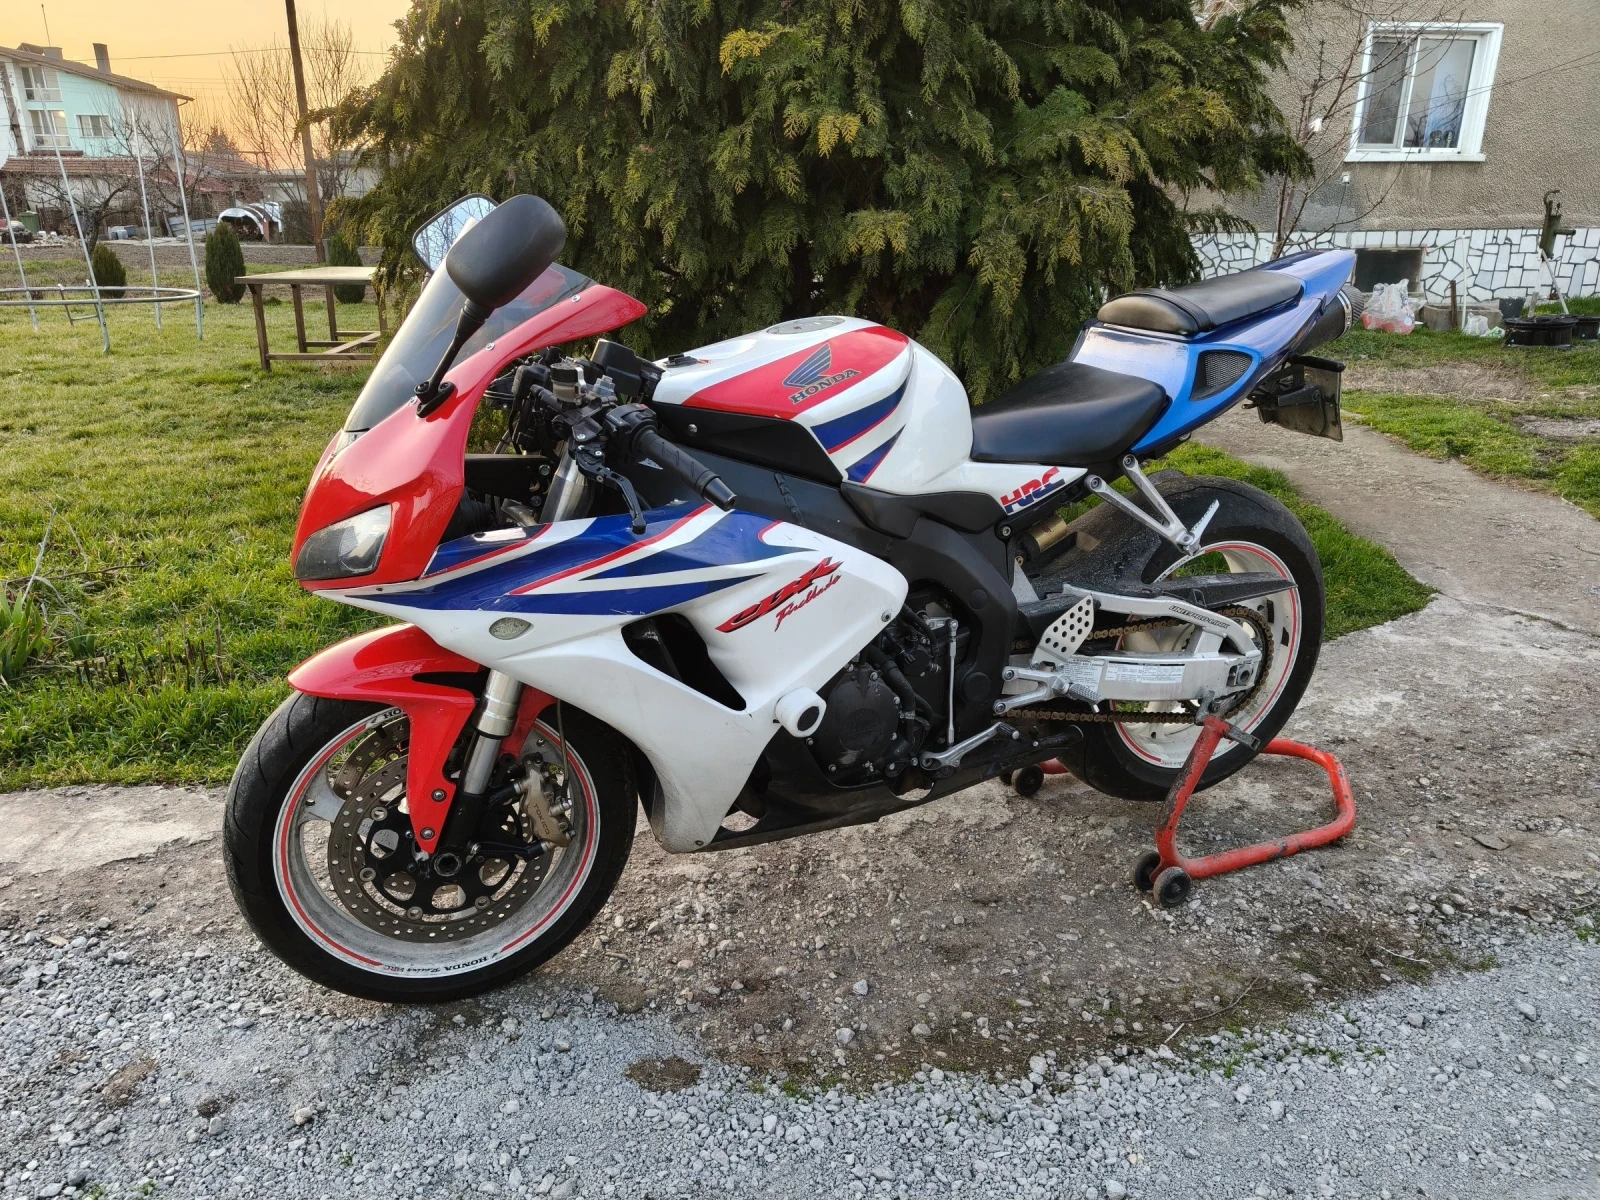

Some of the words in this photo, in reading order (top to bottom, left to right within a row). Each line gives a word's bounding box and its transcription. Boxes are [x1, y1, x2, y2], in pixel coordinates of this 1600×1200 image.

[788, 368, 861, 405] HONDA
[1000, 465, 1066, 514] HRC
[715, 556, 843, 633] CBR
[774, 574, 842, 632] Fireblade
[533, 803, 550, 835] TOKICO
[444, 956, 488, 972] HONDA
